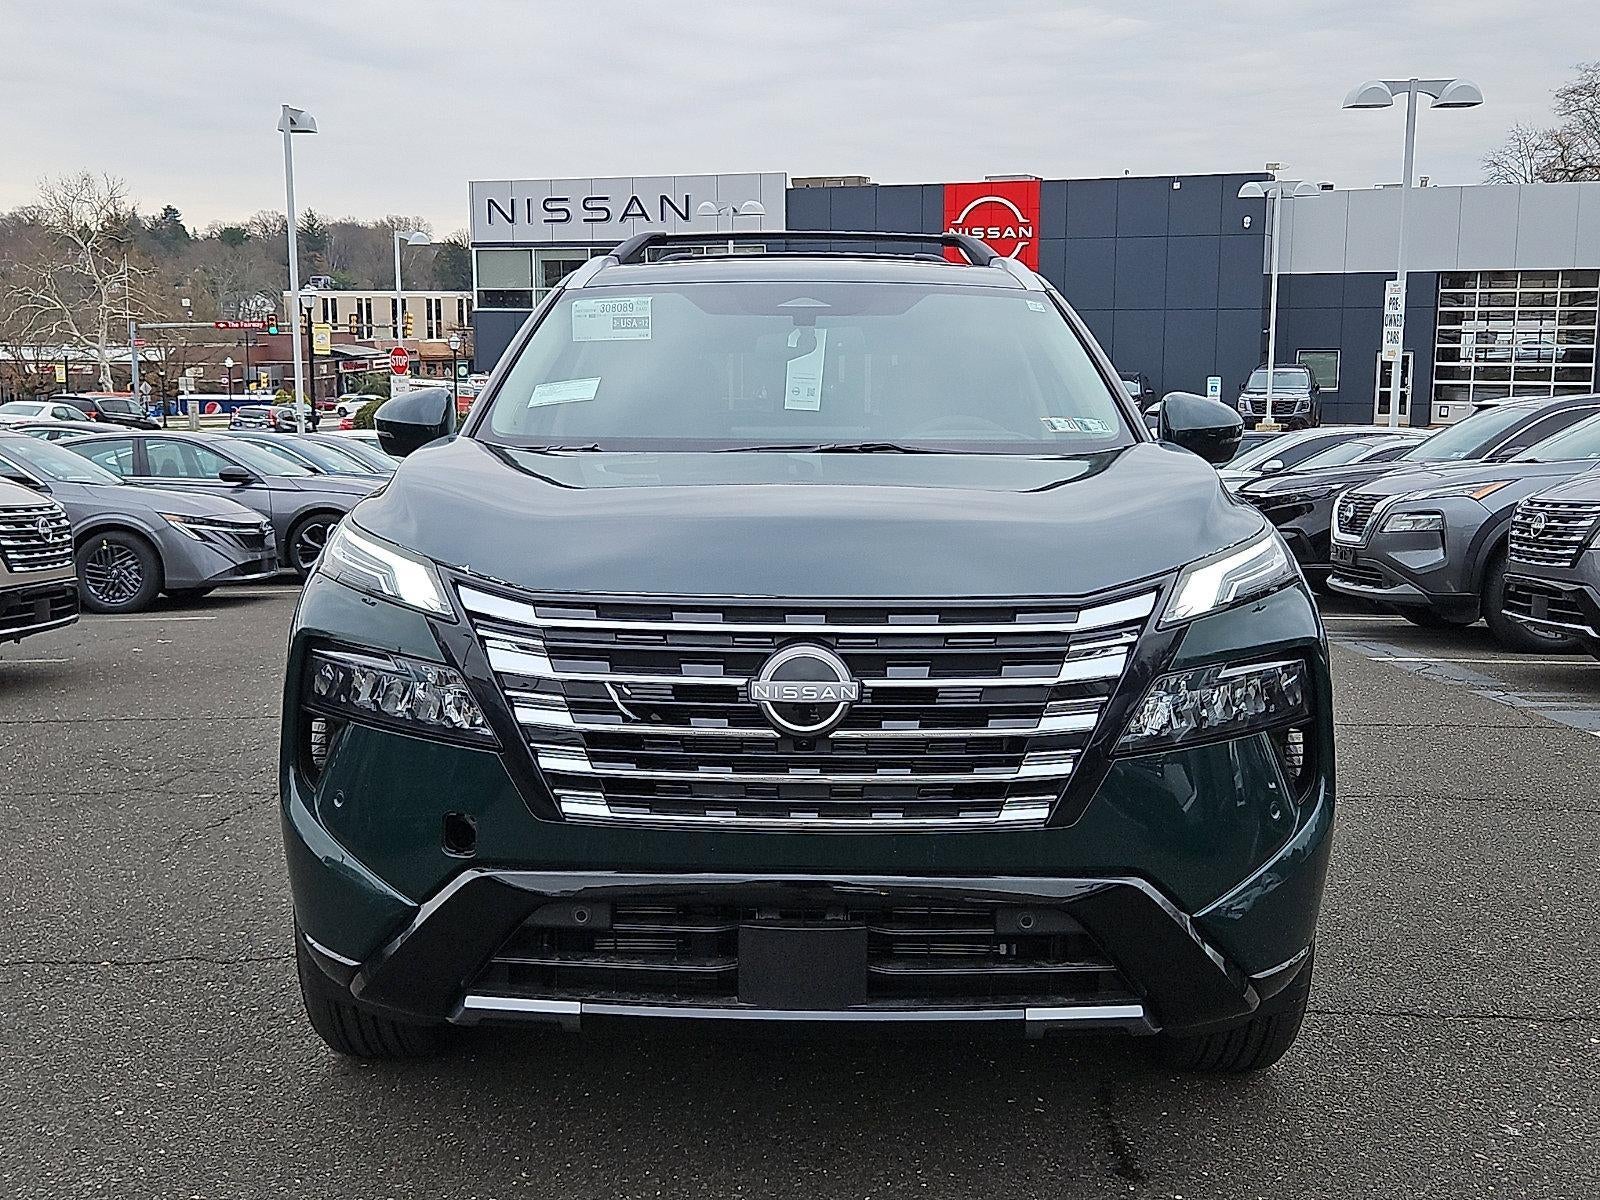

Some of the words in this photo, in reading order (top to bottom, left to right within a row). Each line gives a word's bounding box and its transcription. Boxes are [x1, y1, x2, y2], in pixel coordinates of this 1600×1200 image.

[486, 194, 690, 224] NISSAN
[948, 226, 1033, 239] NISSAN
[240, 321, 264, 329] Fairway
[1385, 313, 1403, 328] OWNED
[391, 355, 408, 367] STOP
[753, 685, 856, 699] NISSAN
